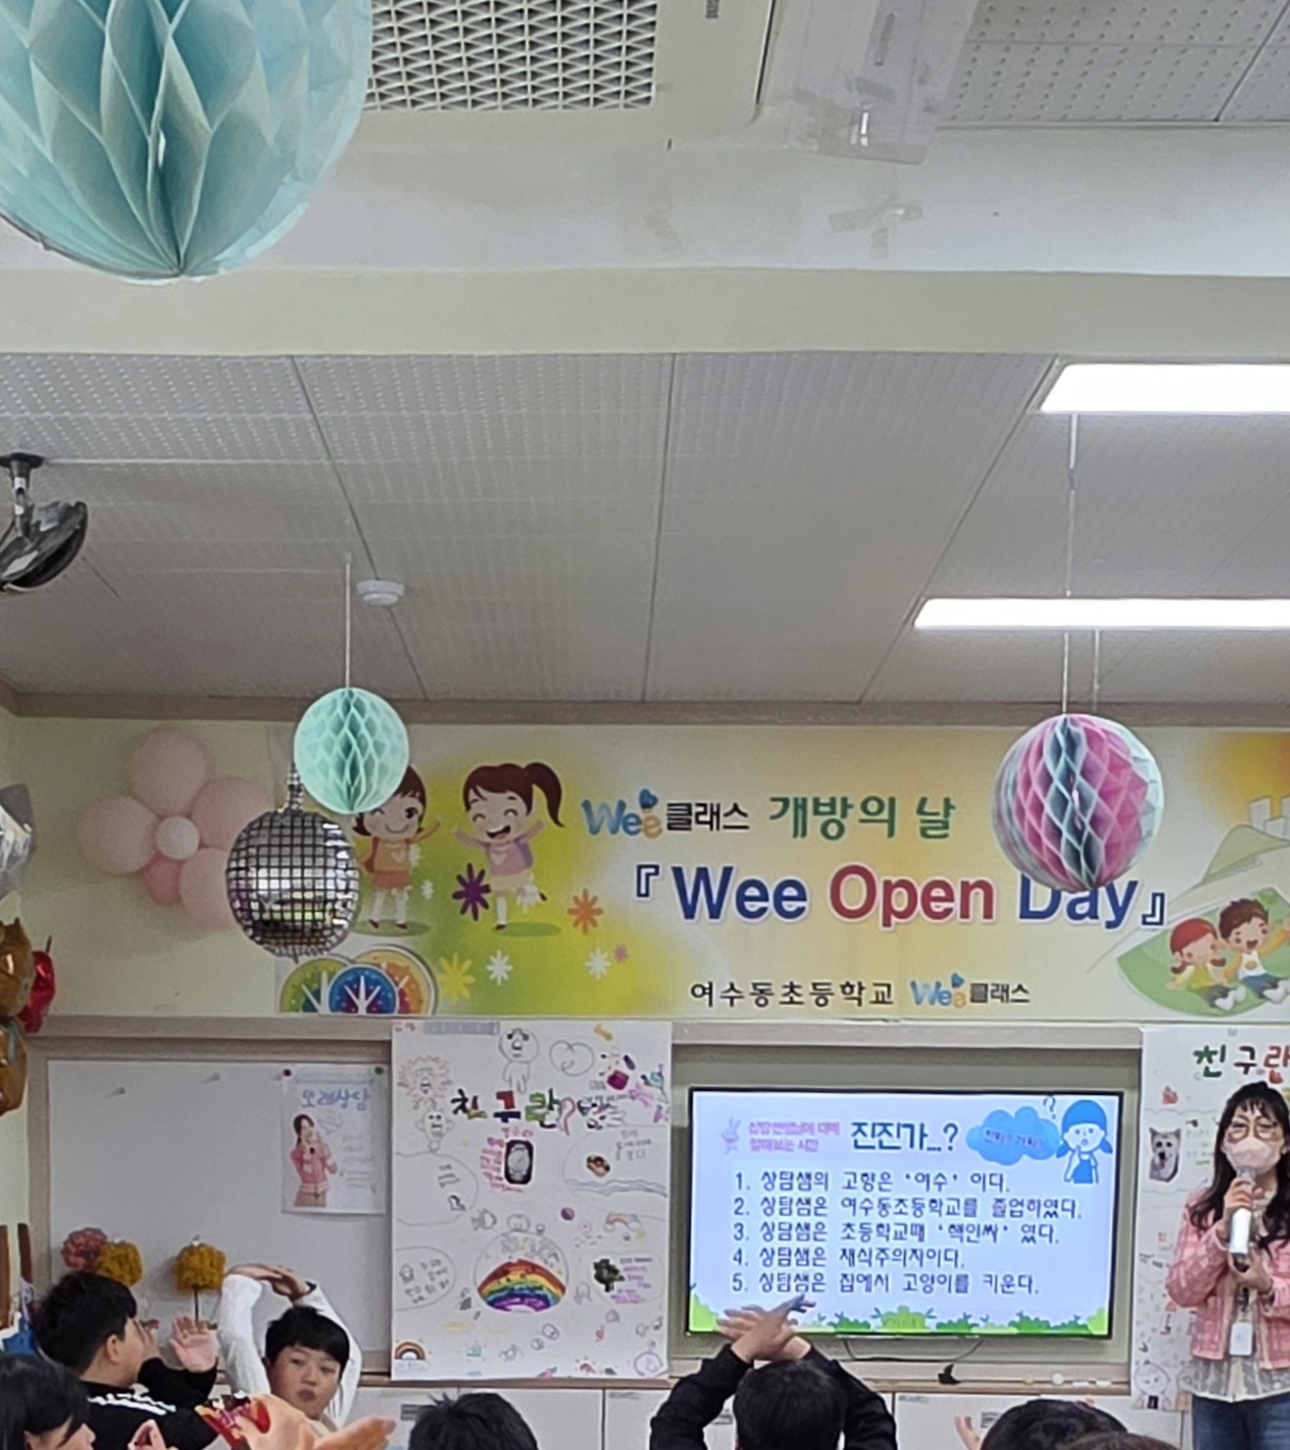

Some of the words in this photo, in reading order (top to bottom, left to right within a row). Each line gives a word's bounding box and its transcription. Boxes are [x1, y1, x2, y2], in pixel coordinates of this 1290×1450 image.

[769, 796, 899, 841] 개방의
[915, 796, 957, 840] 날
[829, 864, 995, 928] Open
[690, 980, 895, 1008] 여수동초등학교
[735, 1171, 751, 1191] 1.
[761, 1170, 829, 1192] 상담샘의
[841, 1171, 893, 1192] 고향은
[969, 1172, 1010, 1193] 이다.
[733, 1196, 751, 1217] 2.
[760, 1196, 828, 1217] 상담샘은
[991, 1197, 1082, 1219] 졸업하였다.
[732, 1221, 750, 1242] 3.
[759, 1221, 827, 1243] 상담샘은
[732, 1247, 749, 1267] 4.
[759, 1247, 827, 1268] 상담샘은
[732, 1272, 749, 1292] 5.
[758, 1272, 827, 1293] 상담샘은
[839, 1273, 889, 1293] 집에서
[902, 1273, 970, 1294] 고양이를
[982, 1274, 1040, 1295] 키운다.
